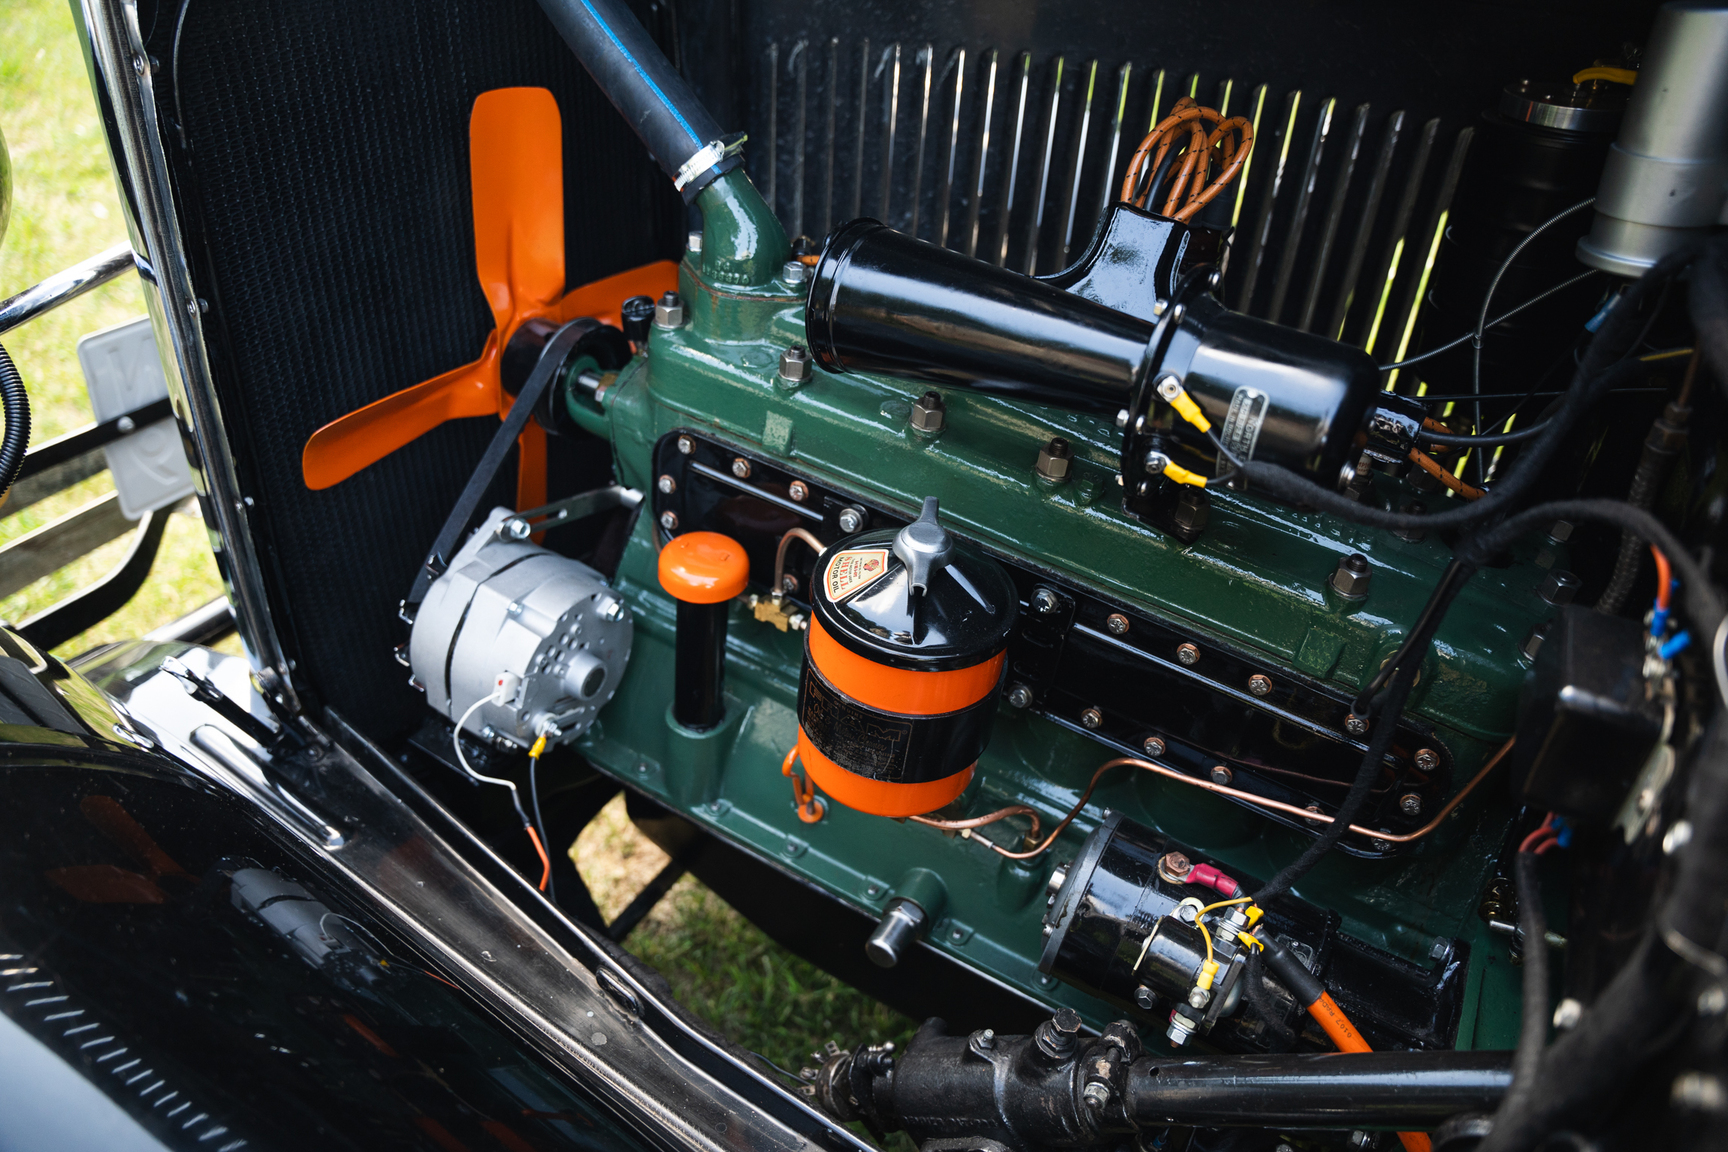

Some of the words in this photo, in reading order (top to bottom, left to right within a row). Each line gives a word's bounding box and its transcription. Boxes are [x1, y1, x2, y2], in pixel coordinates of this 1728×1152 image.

[832, 556, 844, 579] MOTOR
[839, 556, 852, 590] SHELL
[1335, 1018, 1352, 1038] 0107
